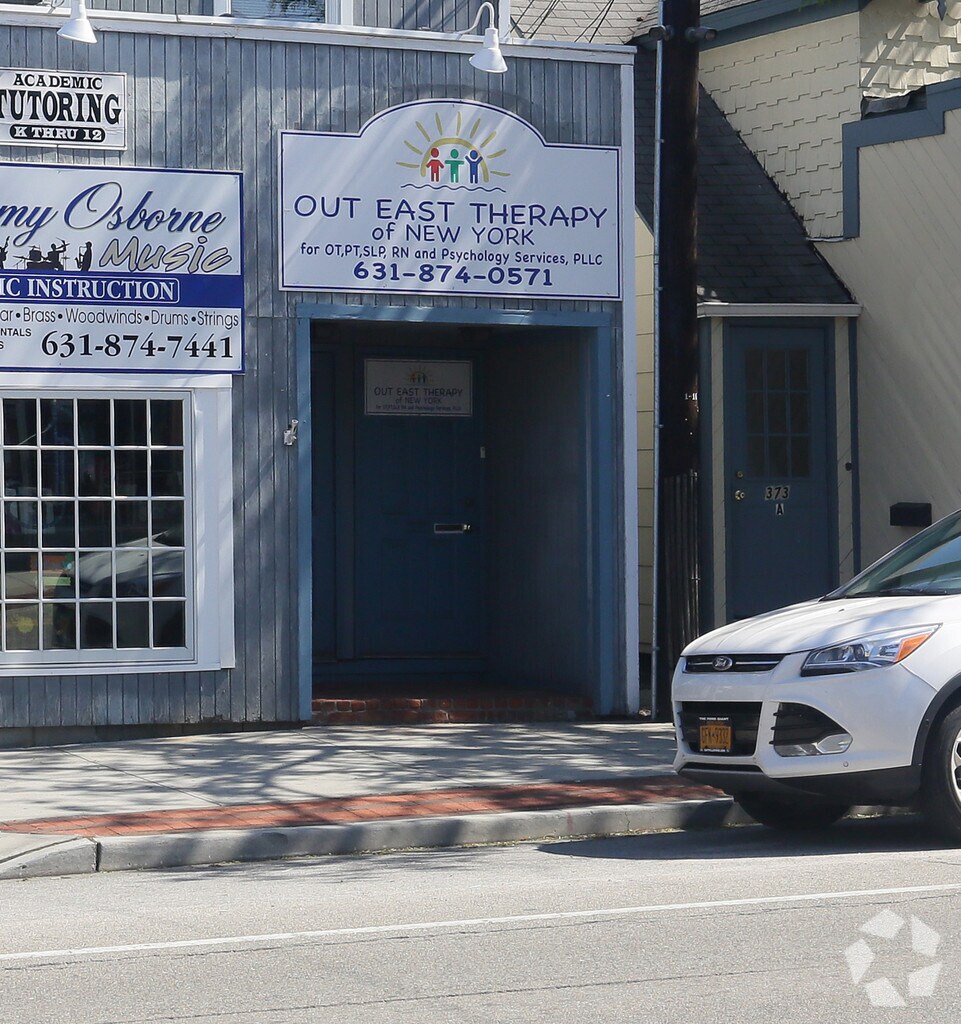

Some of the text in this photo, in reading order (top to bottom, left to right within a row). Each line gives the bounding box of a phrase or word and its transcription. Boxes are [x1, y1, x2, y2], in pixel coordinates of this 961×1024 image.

[13, 73, 103, 90] ACADEMIC
[13, 126, 102, 141] K THRU 12
[64, 181, 226, 234] Osborne
[294, 195, 608, 228] OUT EAST THERAPY
[372, 222, 534, 245] of NEW YORK
[99, 236, 232, 274] Music
[301, 242, 320, 255] for
[392, 246, 409, 258] RN
[414, 248, 436, 259] and
[442, 248, 509, 265] Psychology
[515, 251, 569, 265] Services,
[573, 253, 603, 265] PLLC
[353, 261, 553, 286] 631-874-0571
[27, 278, 174, 301] INSTRUCTION
[23, 306, 56, 323] Brass
[65, 308, 142, 325] Woodwinds
[151, 309, 189, 326] Drums
[197, 310, 239, 330] Strings
[41, 329, 233, 359] 631-874-7441
[374, 387, 463, 397] OUT EAST THERAPY
[766, 486, 789, 500] 373
[776, 503, 783, 515] A
